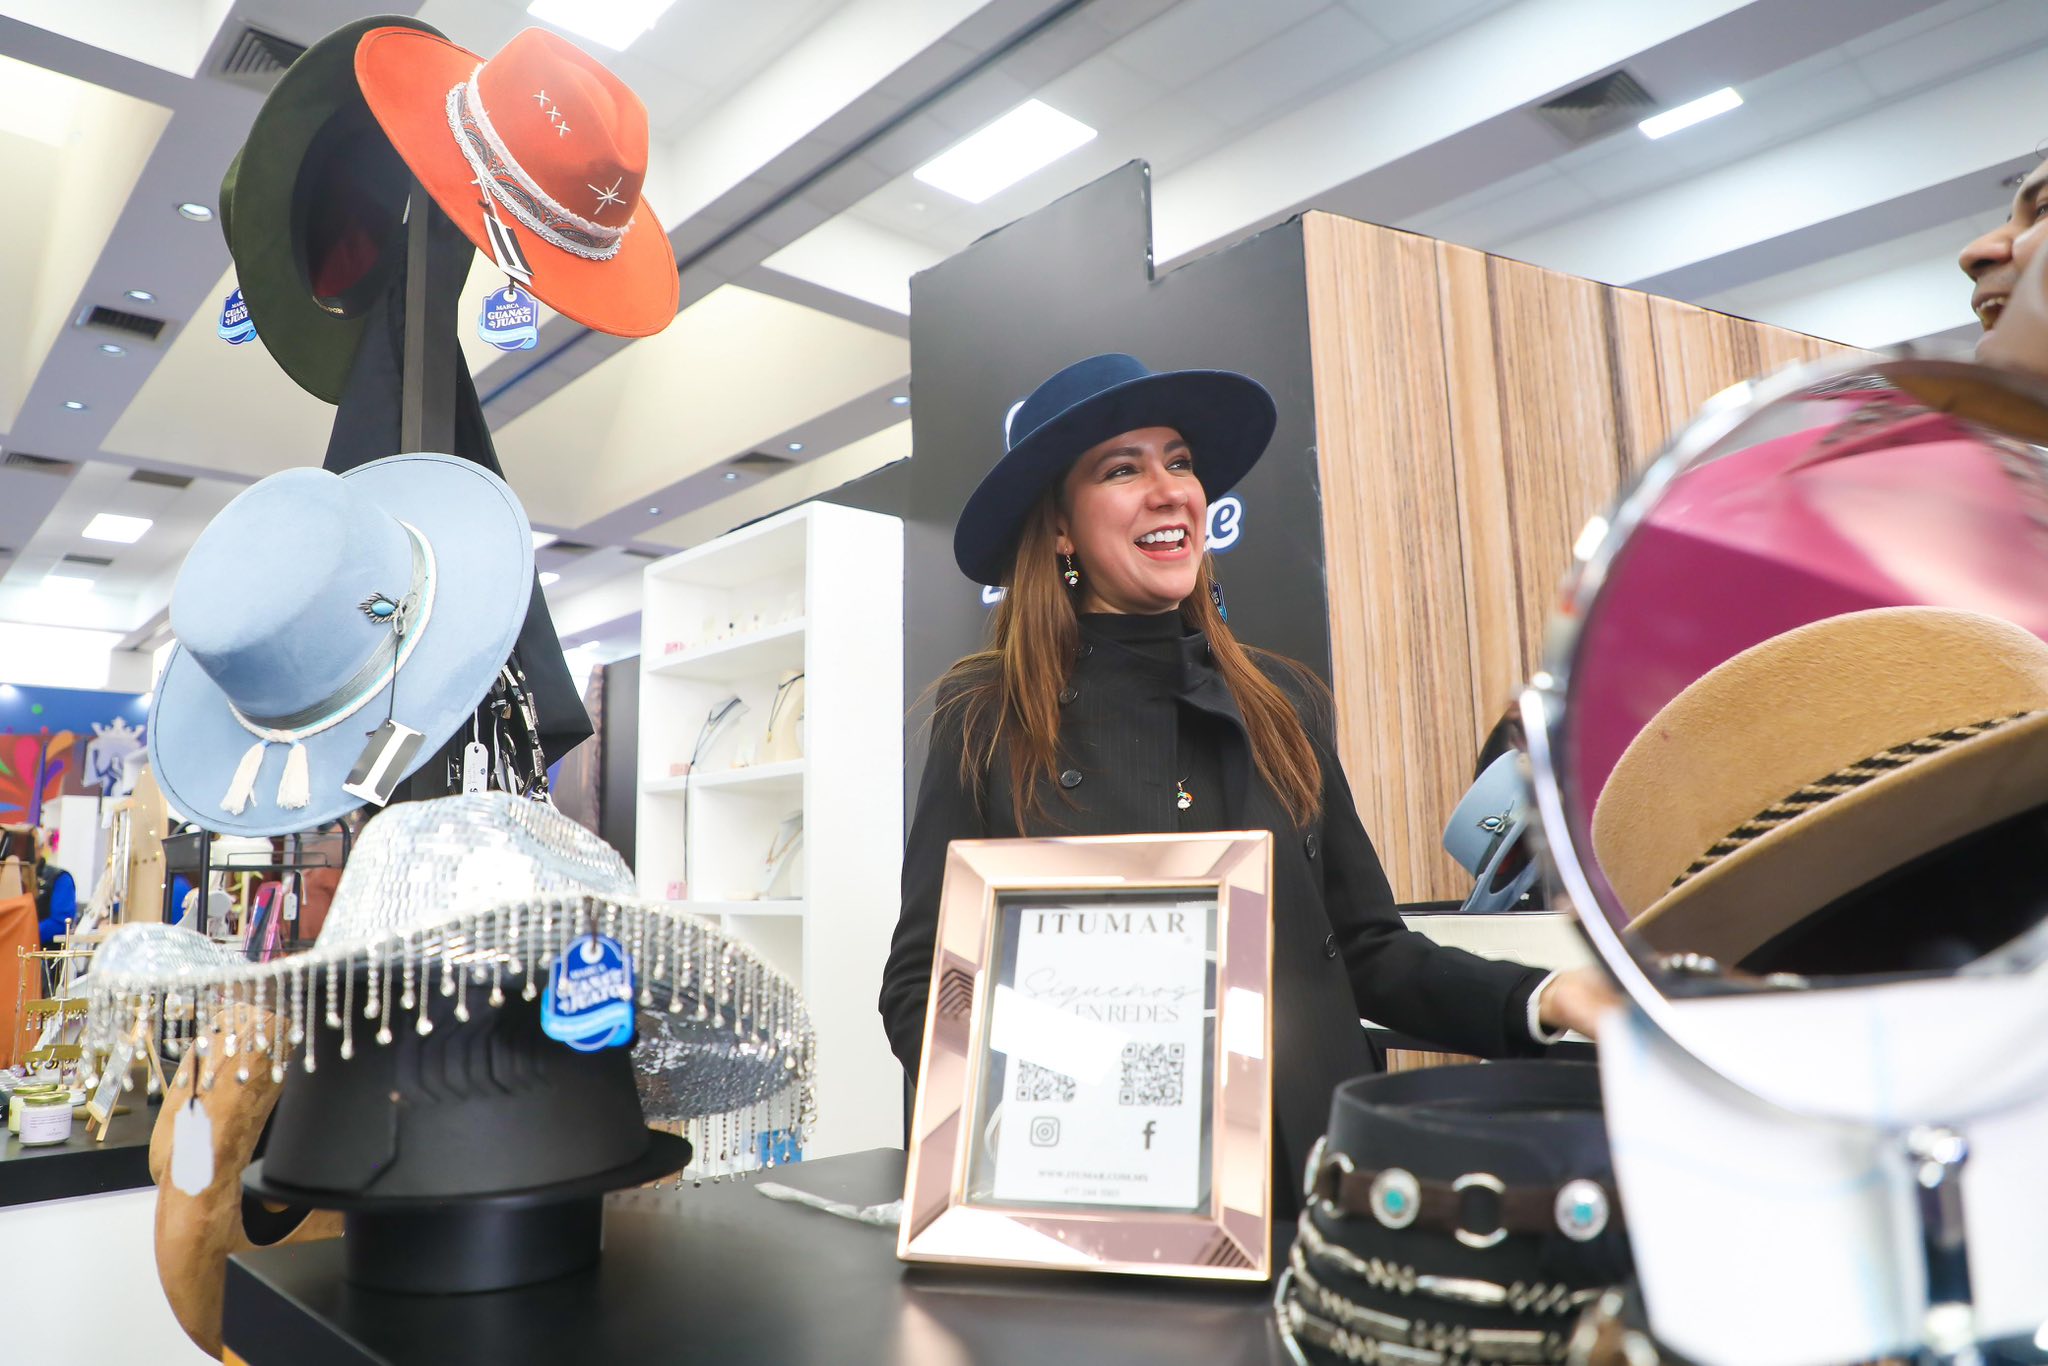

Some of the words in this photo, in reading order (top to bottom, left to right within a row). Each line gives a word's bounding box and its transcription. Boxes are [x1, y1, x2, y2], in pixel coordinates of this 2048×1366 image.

[225, 304, 247, 318] GUAN
[487, 308, 522, 320] GUANA
[496, 303, 520, 311] MARCA
[230, 310, 248, 325] JUAT
[496, 315, 532, 328] JUATO
[1036, 912, 1186, 935] ITUMAR
[1107, 1004, 1180, 1024] REDES
